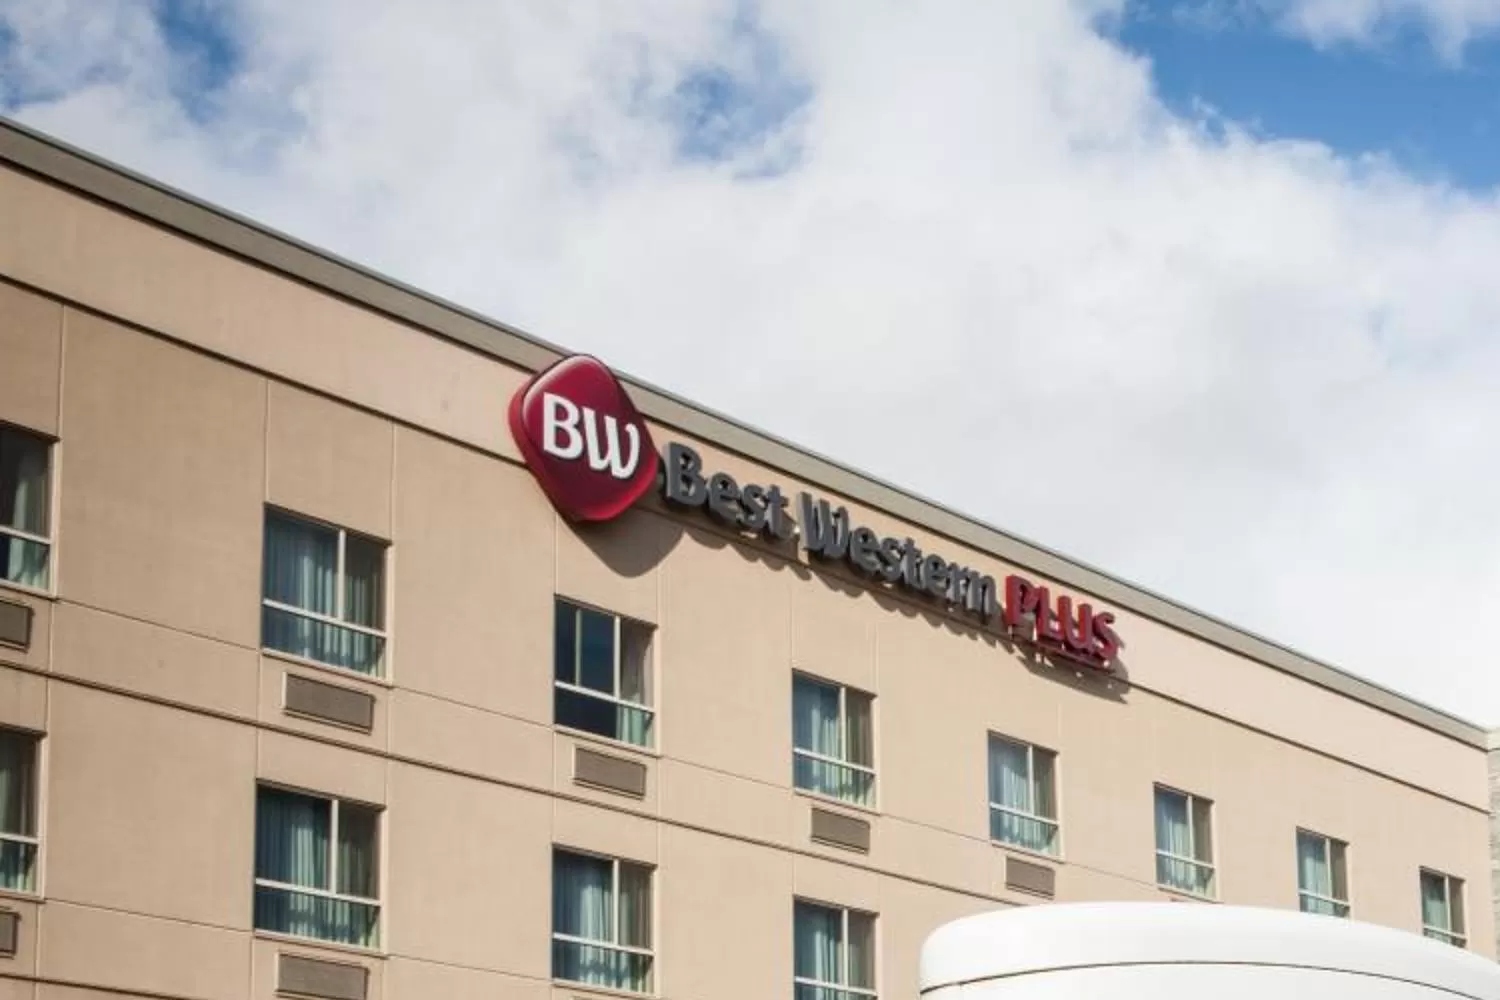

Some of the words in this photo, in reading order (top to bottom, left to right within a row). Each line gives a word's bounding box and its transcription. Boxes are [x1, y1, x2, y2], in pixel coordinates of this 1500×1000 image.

[543, 391, 640, 479] BW
[665, 441, 791, 539] Best
[799, 491, 998, 617] Western
[1004, 574, 1119, 664] PLUS
